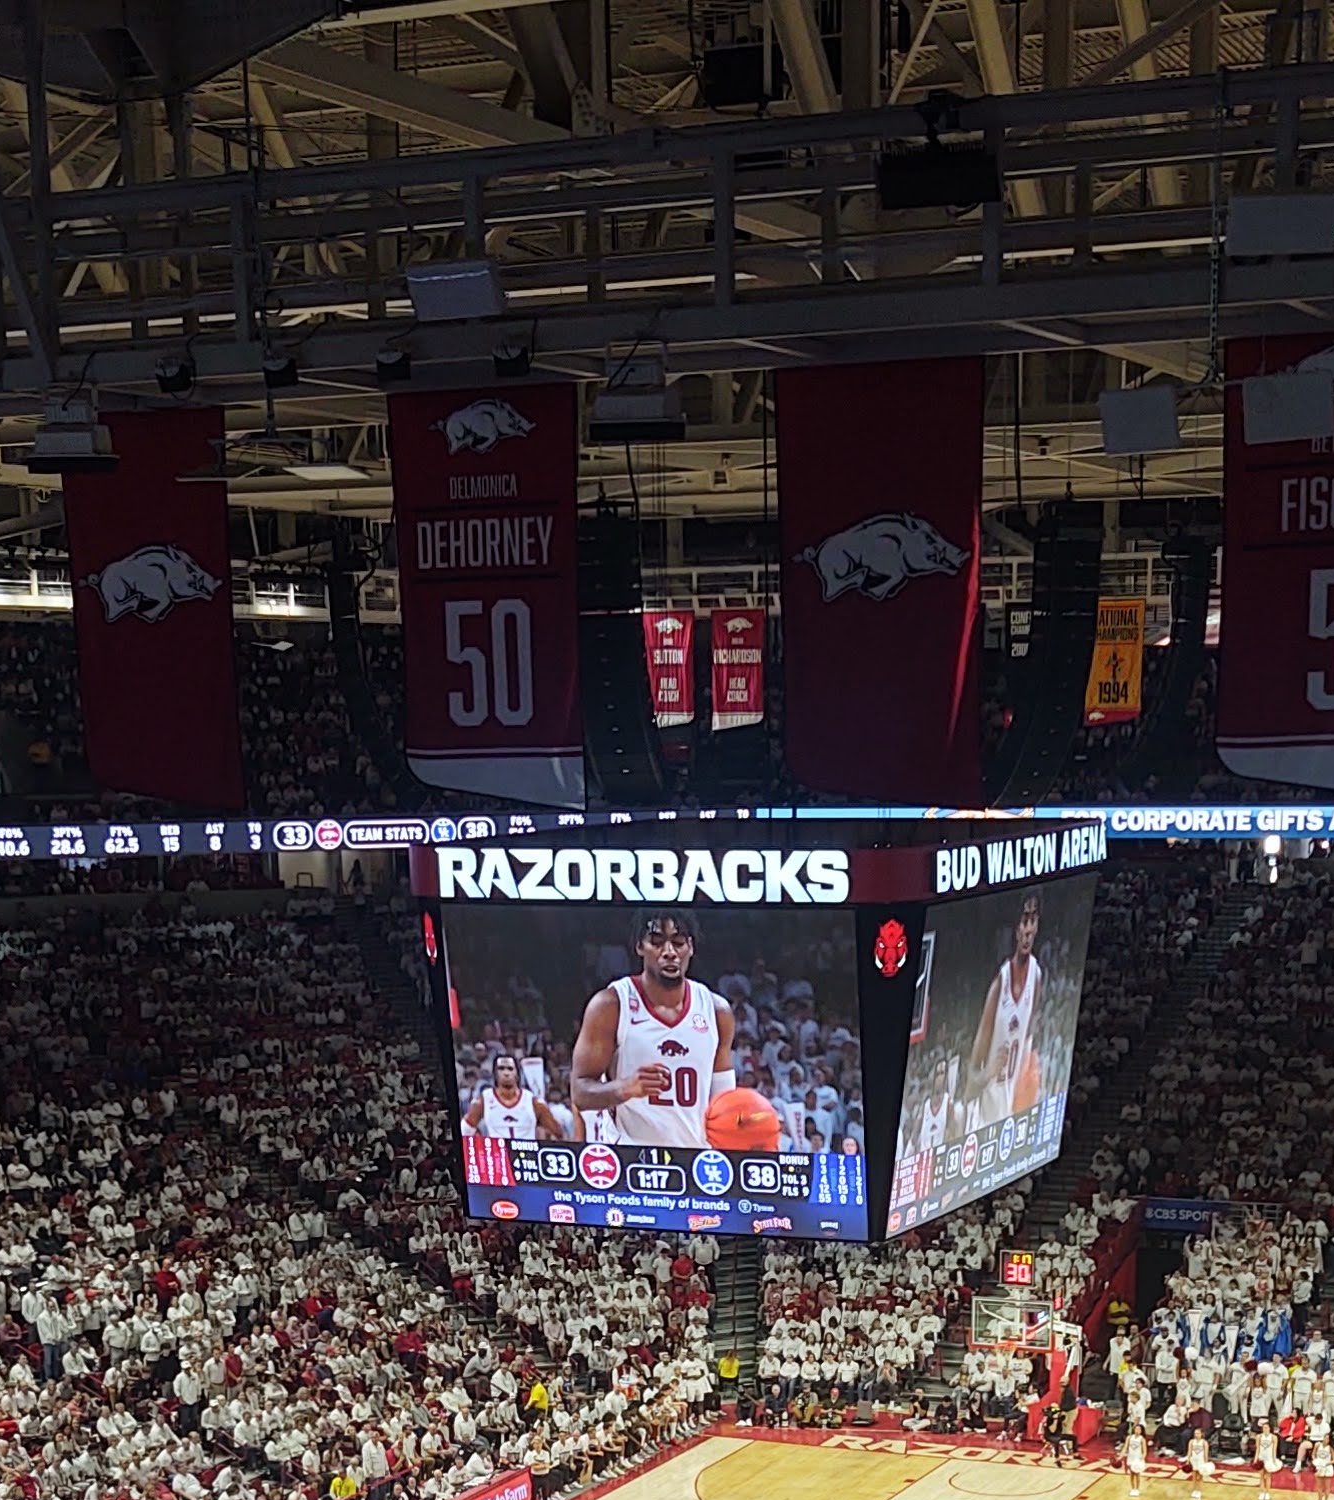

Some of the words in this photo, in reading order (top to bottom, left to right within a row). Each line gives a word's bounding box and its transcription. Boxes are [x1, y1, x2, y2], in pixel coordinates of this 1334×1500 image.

[449, 473, 518, 500] DELMONICA
[417, 515, 554, 570] DEHORNEY
[1099, 609, 1139, 626] ATIONAL
[445, 597, 535, 728] 50
[653, 648, 684, 665] SUTTON
[1098, 681, 1128, 704] 1994
[110, 825, 134, 838] FT%
[205, 822, 225, 835] AST
[247, 822, 263, 835] TO
[1111, 809, 1254, 833] CORPORATE
[1256, 808, 1324, 832] GIFTS
[283, 826, 308, 845] 33
[350, 826, 384, 843] TEAM
[385, 826, 424, 841] STATS
[50, 839, 86, 855] 28.6
[104, 837, 140, 854] 62.5
[162, 836, 181, 852] 15
[210, 835, 222, 851] 8
[250, 834, 262, 850] 3
[936, 845, 981, 894] BUD
[986, 832, 1056, 885] WALTON
[1060, 822, 1108, 871] ARENA
[436, 847, 851, 904] RAZORBACKS
[511, 1141, 539, 1151] BONUS
[513, 1159, 520, 1168] 4
[522, 1160, 538, 1170] TOL
[546, 1154, 570, 1176] 33
[650, 1149, 658, 1165] 1
[779, 1154, 809, 1166] BONUS
[514, 1171, 521, 1181] 9
[523, 1172, 539, 1182] FLS
[637, 1170, 669, 1189] 1:17
[747, 1165, 775, 1187] 38
[782, 1174, 799, 1184] TOL
[554, 1190, 572, 1202] the
[573, 1191, 606, 1205] Tyson
[607, 1193, 641, 1207] Foods
[643, 1196, 675, 1210] family
[678, 1198, 690, 1209] of
[692, 1199, 730, 1212] brands
[782, 1186, 798, 1197] FLS
[1154, 1208, 1177, 1220] CBS
[1178, 1208, 1210, 1222] SPOR
[1006, 1263, 1032, 1283] 30
